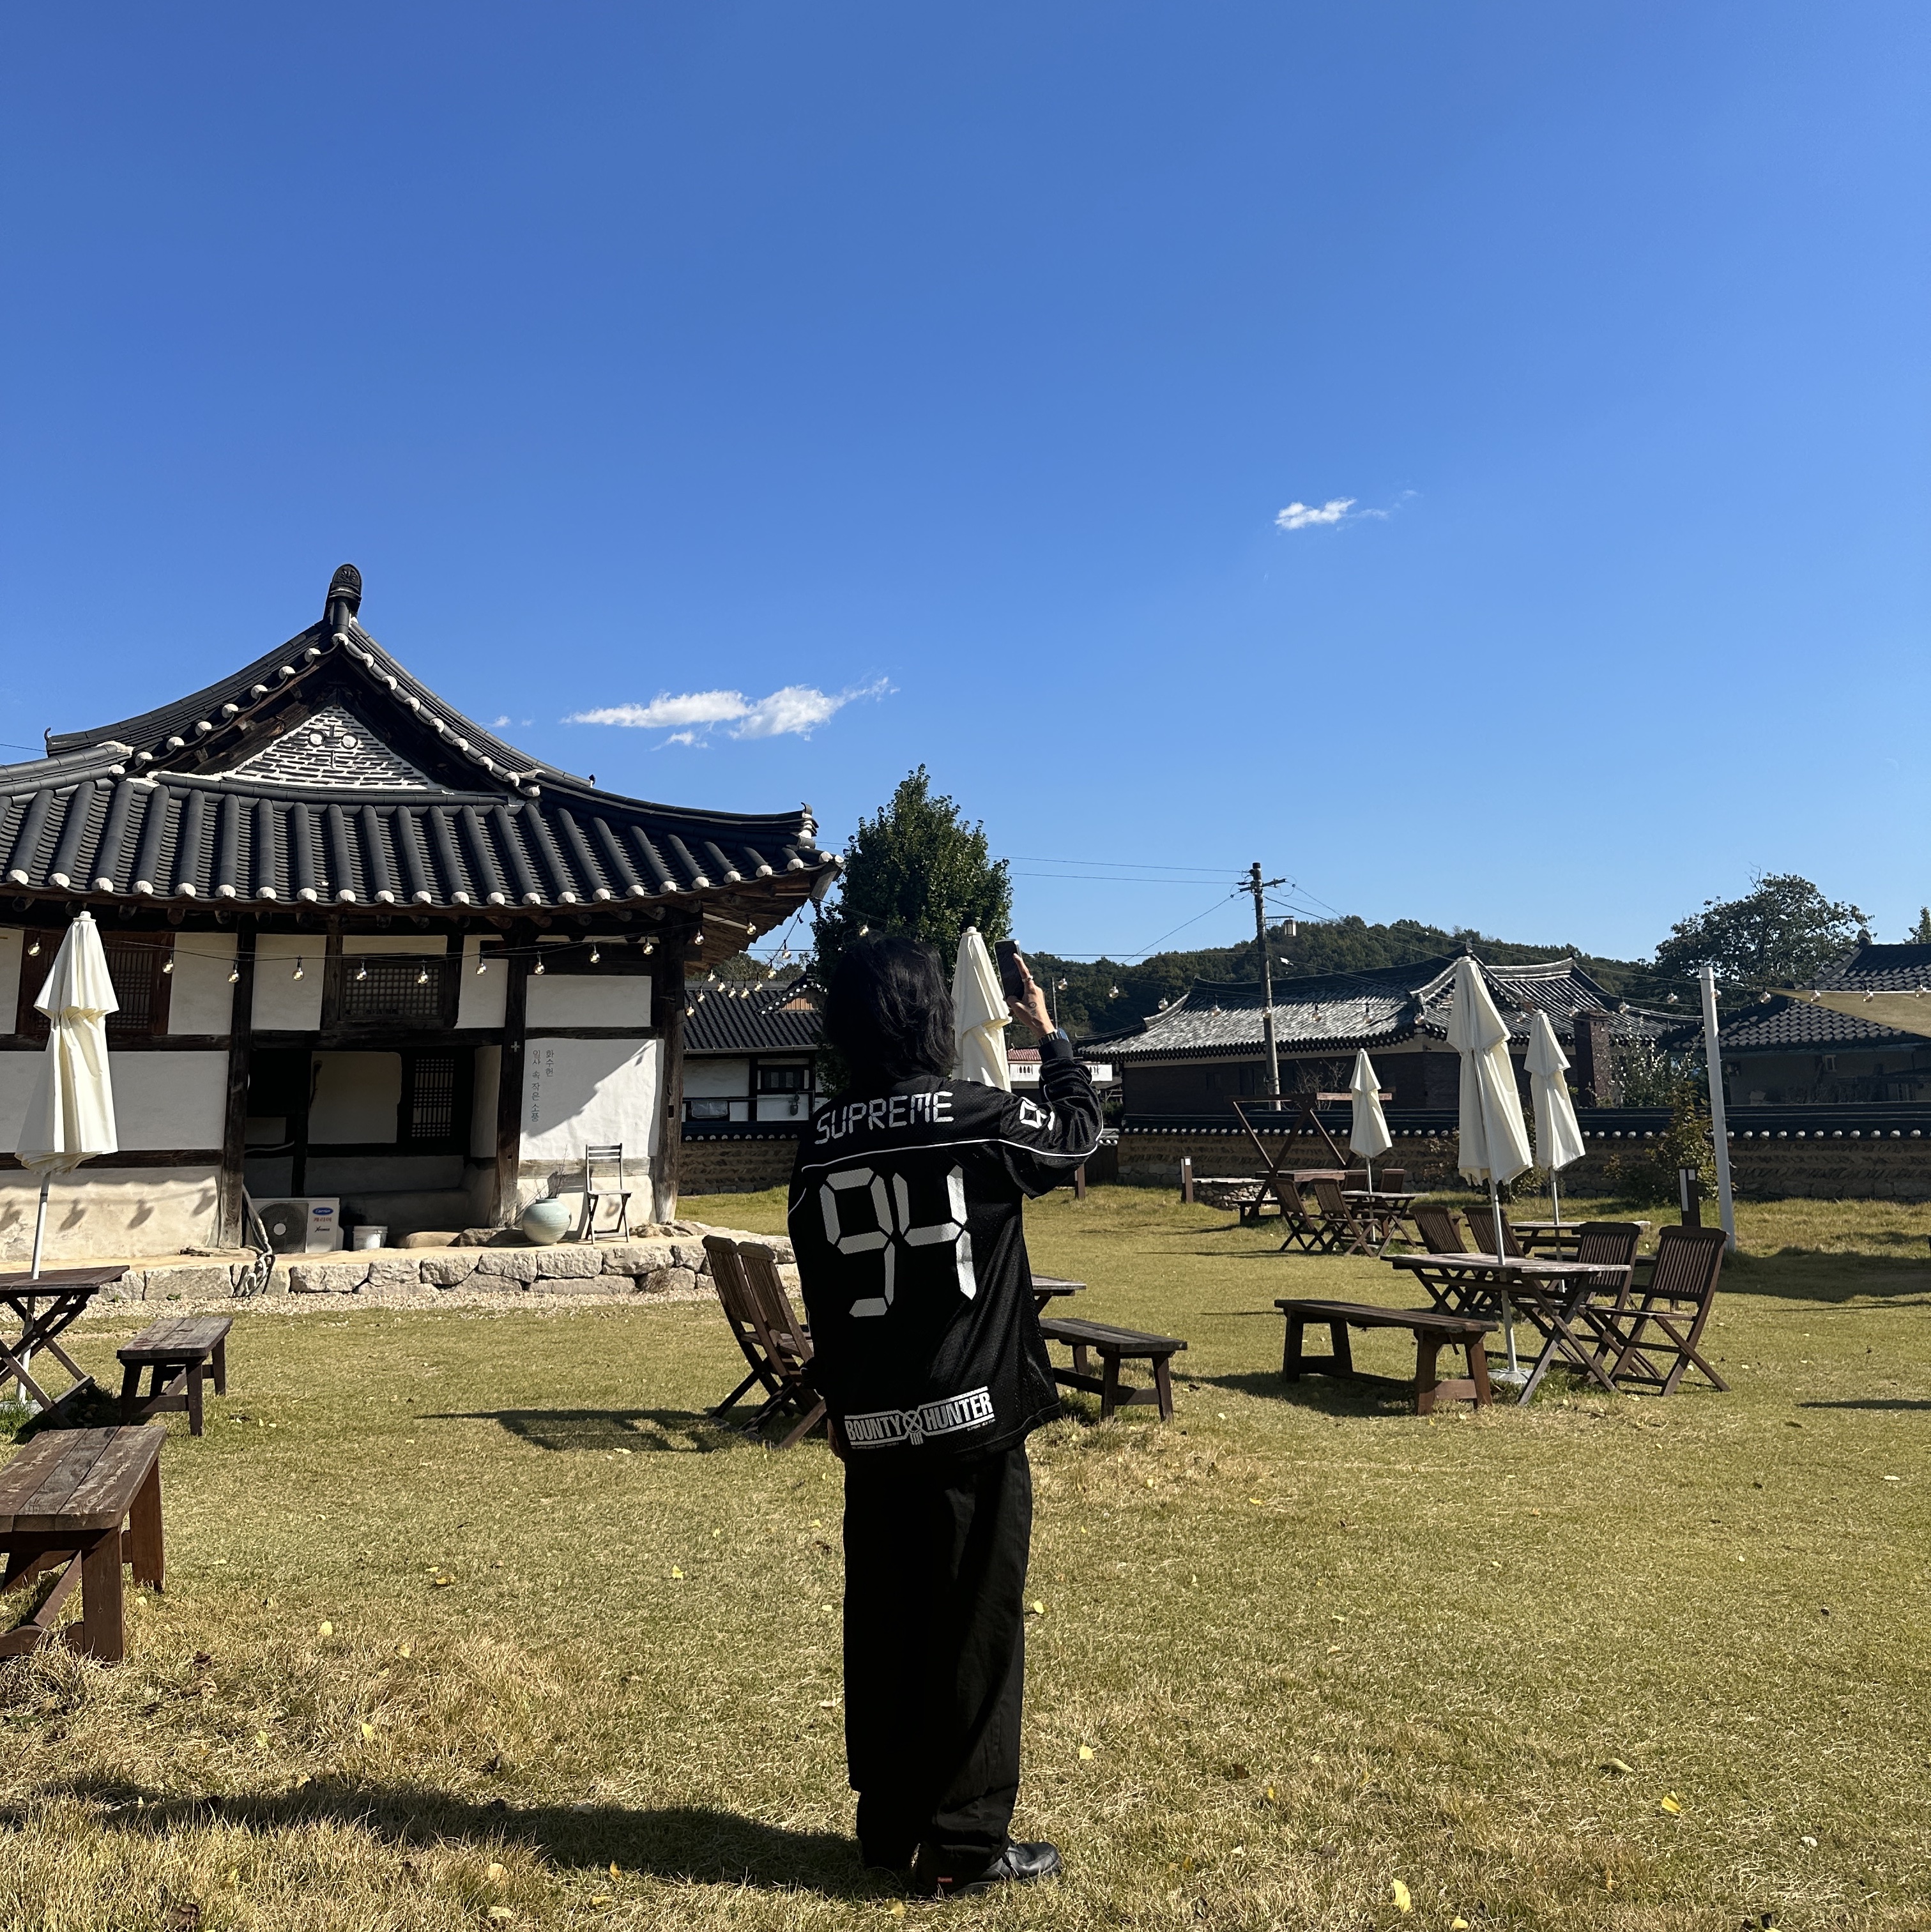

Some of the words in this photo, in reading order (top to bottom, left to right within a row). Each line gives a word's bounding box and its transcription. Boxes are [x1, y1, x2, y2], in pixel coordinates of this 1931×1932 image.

[531, 1070, 540, 1079] 속
[546, 1049, 554, 1077] 화수헌
[531, 1082, 540, 1101] 작은
[531, 1103, 540, 1122] 소풍
[814, 1091, 954, 1145] SUPREME
[819, 1165, 977, 1318] 94
[844, 1414, 902, 1441] BOUNTY
[923, 1392, 993, 1431] HUNTER
